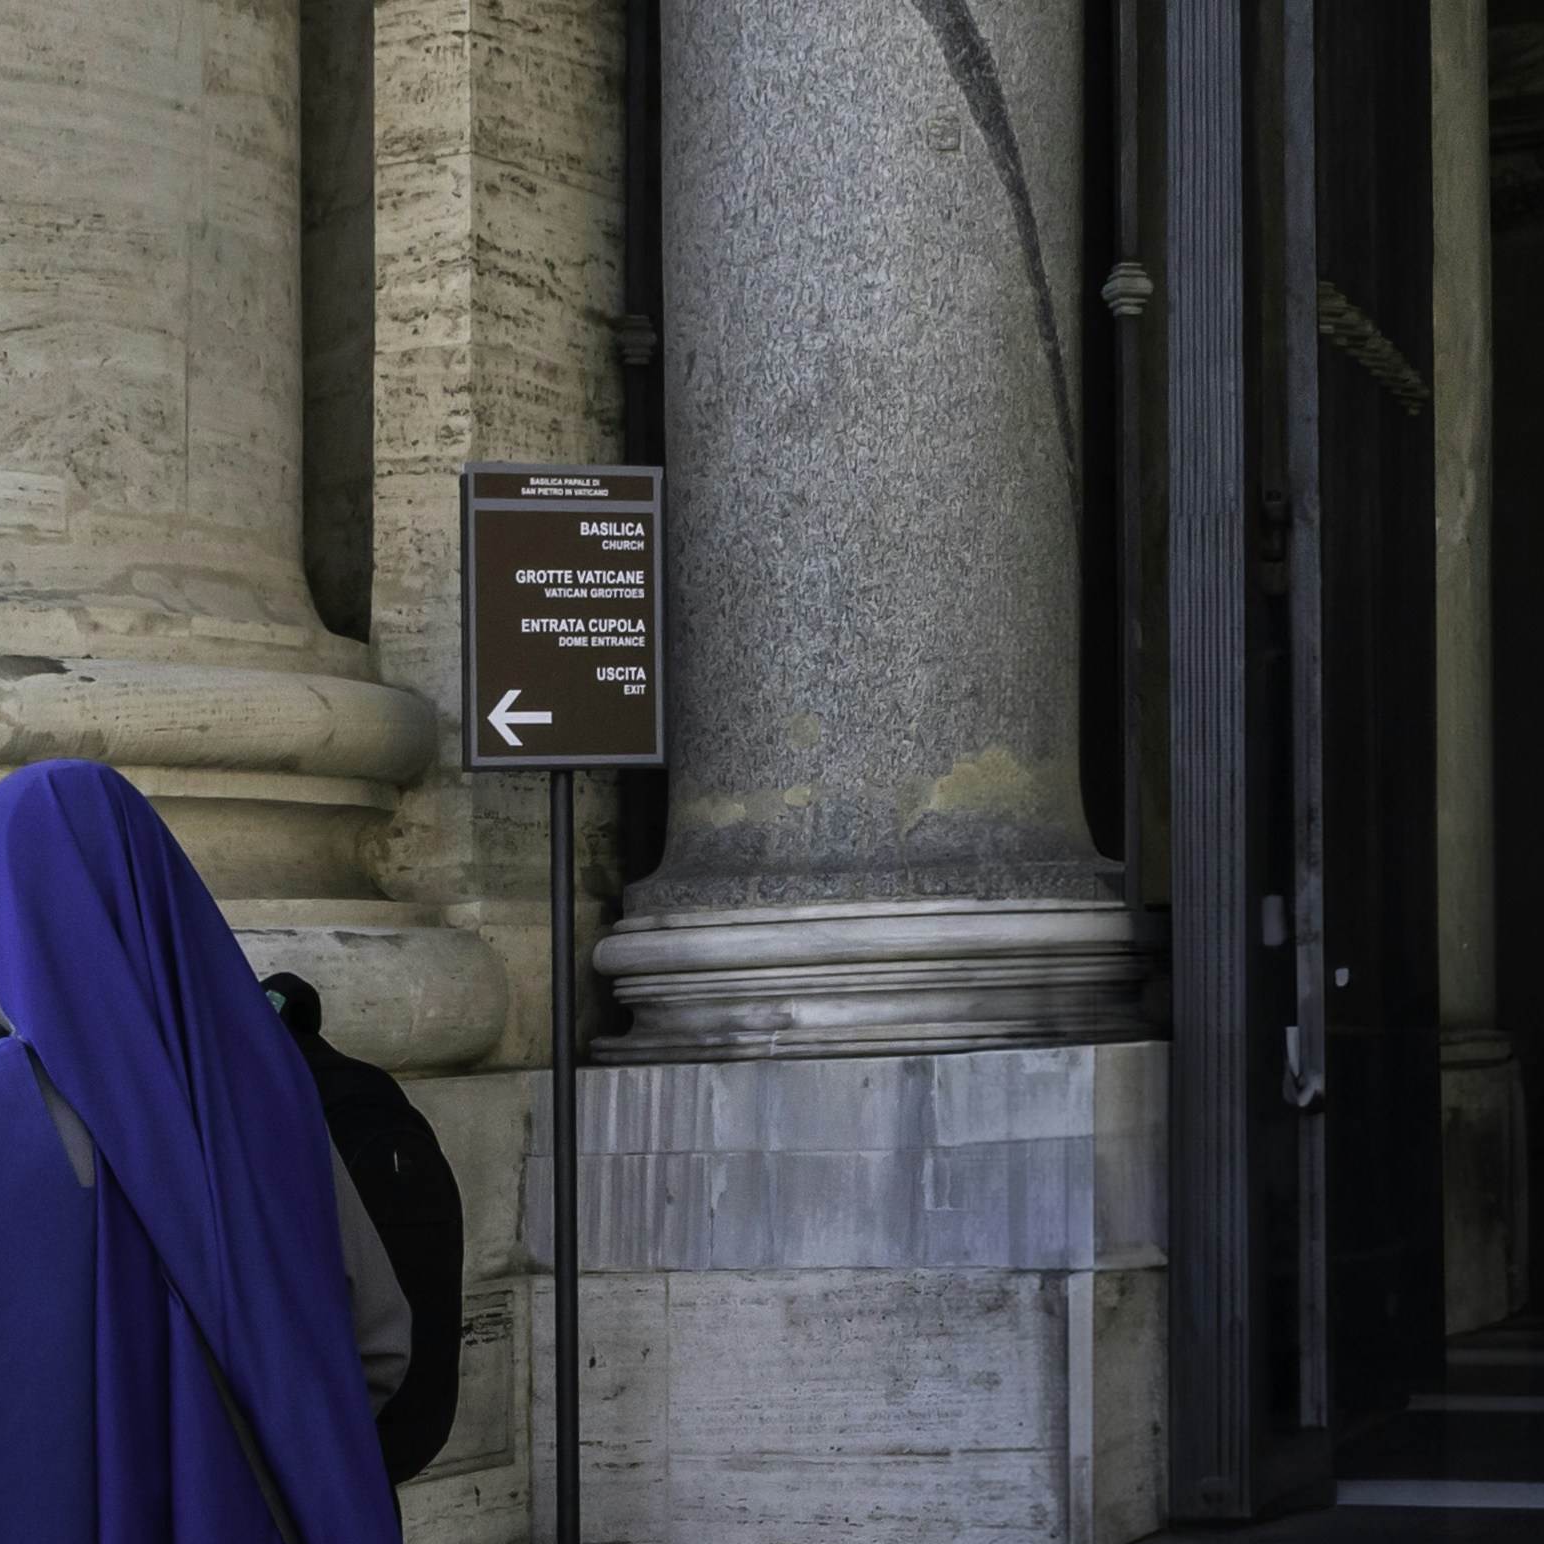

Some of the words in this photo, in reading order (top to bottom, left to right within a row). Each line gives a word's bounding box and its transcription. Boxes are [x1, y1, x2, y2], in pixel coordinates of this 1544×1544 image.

[581, 522, 644, 536] BASILICA
[602, 540, 644, 550] CHURCH
[516, 570, 573, 583] GROTTE
[577, 570, 644, 584] VATICANE
[545, 588, 587, 598] VATICAN
[590, 588, 644, 598] GROTTOES
[522, 619, 585, 632] ENTRATA
[589, 619, 645, 632] CUPOLA
[559, 636, 588, 646] DOME
[591, 636, 644, 646] ENTRANCE
[597, 667, 646, 680] USCITA
[624, 685, 646, 695] EXIT
